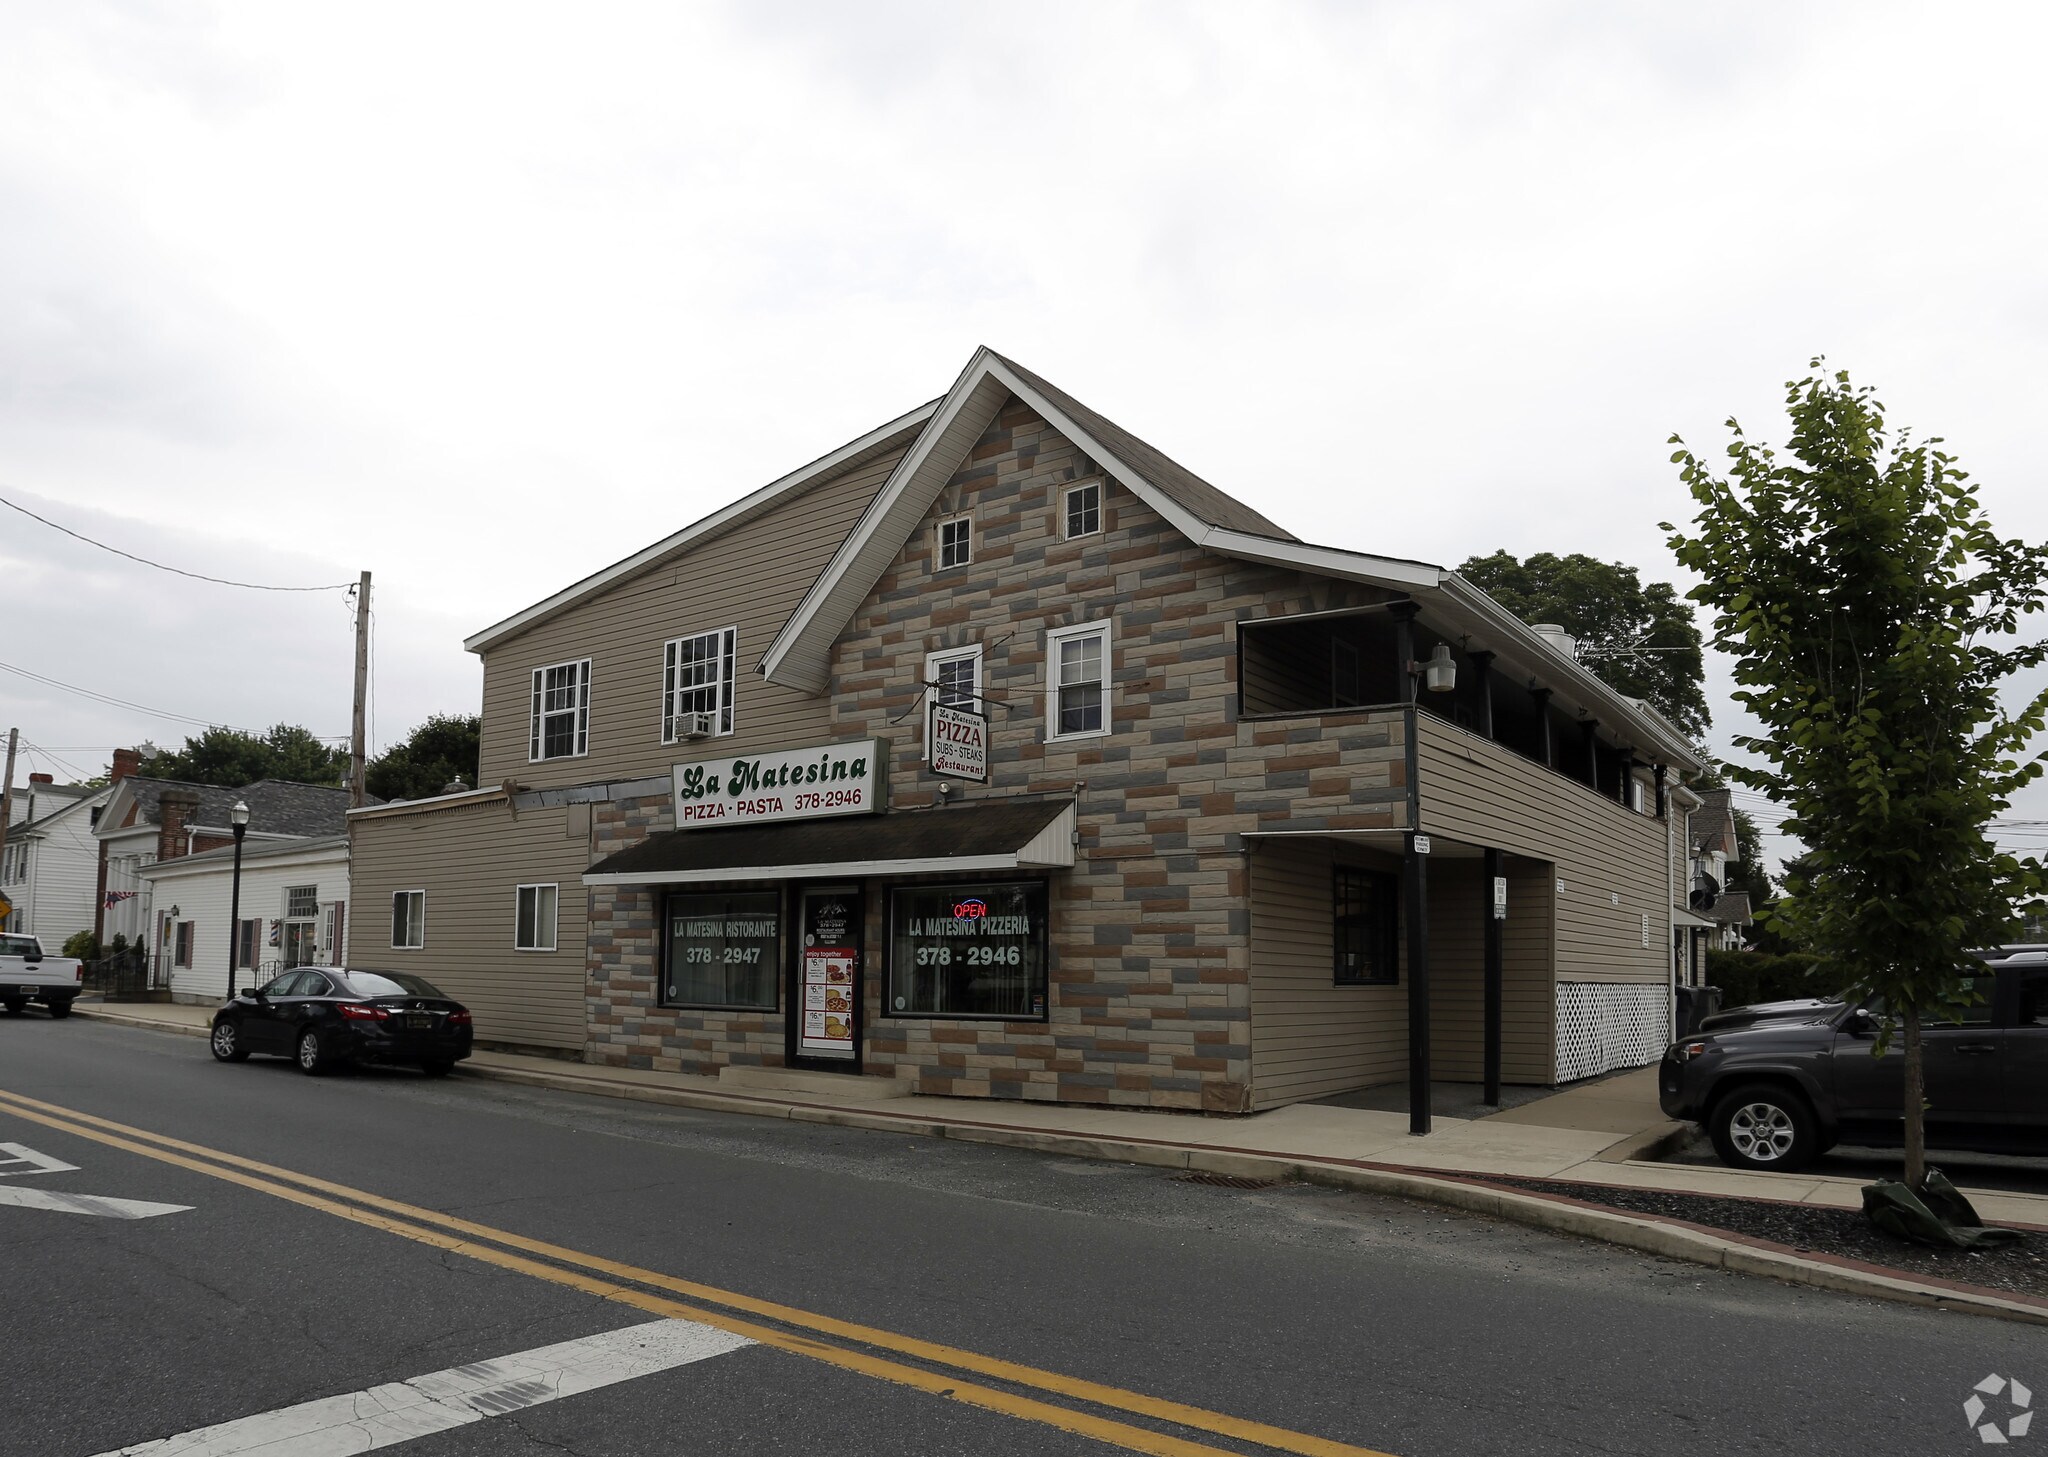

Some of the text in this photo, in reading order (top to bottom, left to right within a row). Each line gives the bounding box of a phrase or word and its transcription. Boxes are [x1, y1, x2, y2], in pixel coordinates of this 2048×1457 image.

[936, 719, 982, 747] PIZZA
[936, 741, 953, 756] SUBS
[959, 746, 983, 762] STEAKS
[935, 755, 984, 775] Restaurant
[680, 753, 868, 800] La Matesina
[684, 788, 862, 820] PIZZA PASTA 378-2946
[954, 903, 987, 918] OPEN
[674, 920, 776, 938] LA MATESINA RISTORANTE
[909, 915, 1030, 936] LA MATESINA PIZZERIA
[686, 947, 712, 963] 378
[723, 947, 761, 964] 2947
[820, 950, 842, 958] together
[916, 947, 951, 966] 378
[966, 946, 1020, 965] 2946
